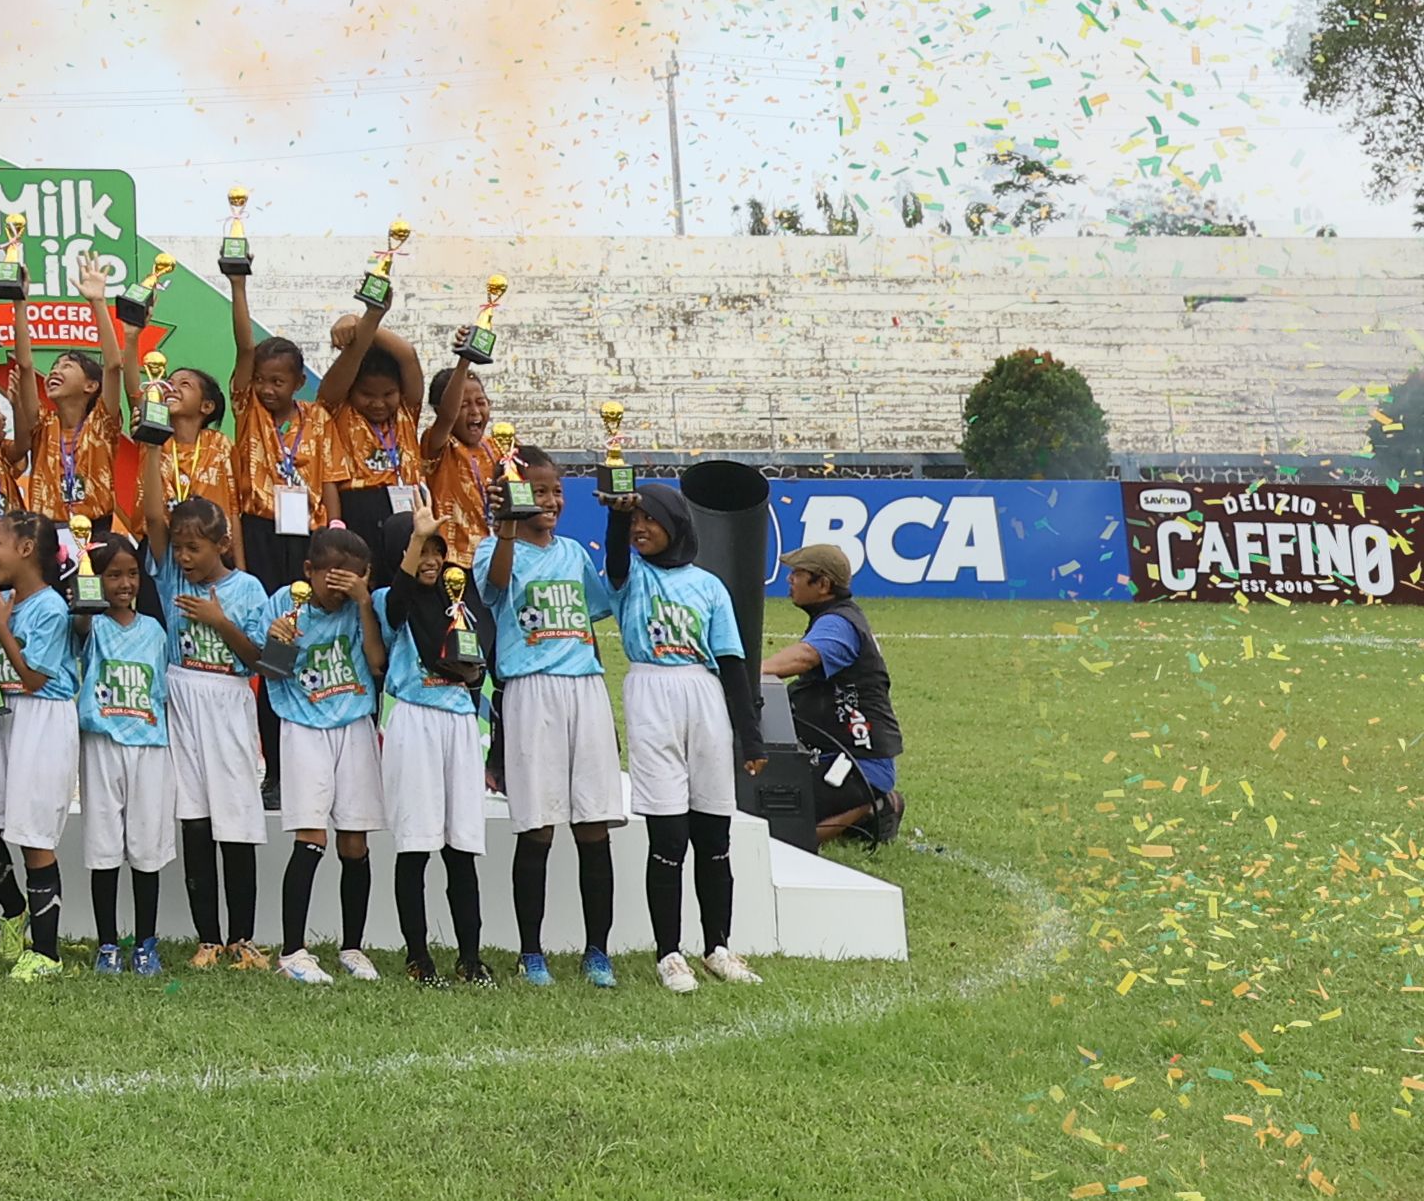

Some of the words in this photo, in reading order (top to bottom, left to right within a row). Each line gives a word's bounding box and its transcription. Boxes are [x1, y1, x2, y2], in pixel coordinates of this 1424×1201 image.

[11, 305, 93, 323] OCCER
[1143, 493, 1188, 506] SAVORIA
[1222, 493, 1317, 516] DELIZIO
[799, 495, 1005, 584] BCA
[1157, 519, 1395, 597] CAFFINO
[532, 583, 583, 608] Milk
[1242, 580, 1273, 593] EST.
[1275, 580, 1314, 594] 2018
[543, 606, 587, 630] Life
[105, 664, 148, 689] Milk
[323, 662, 354, 687] Life
[112, 685, 151, 709] Life
